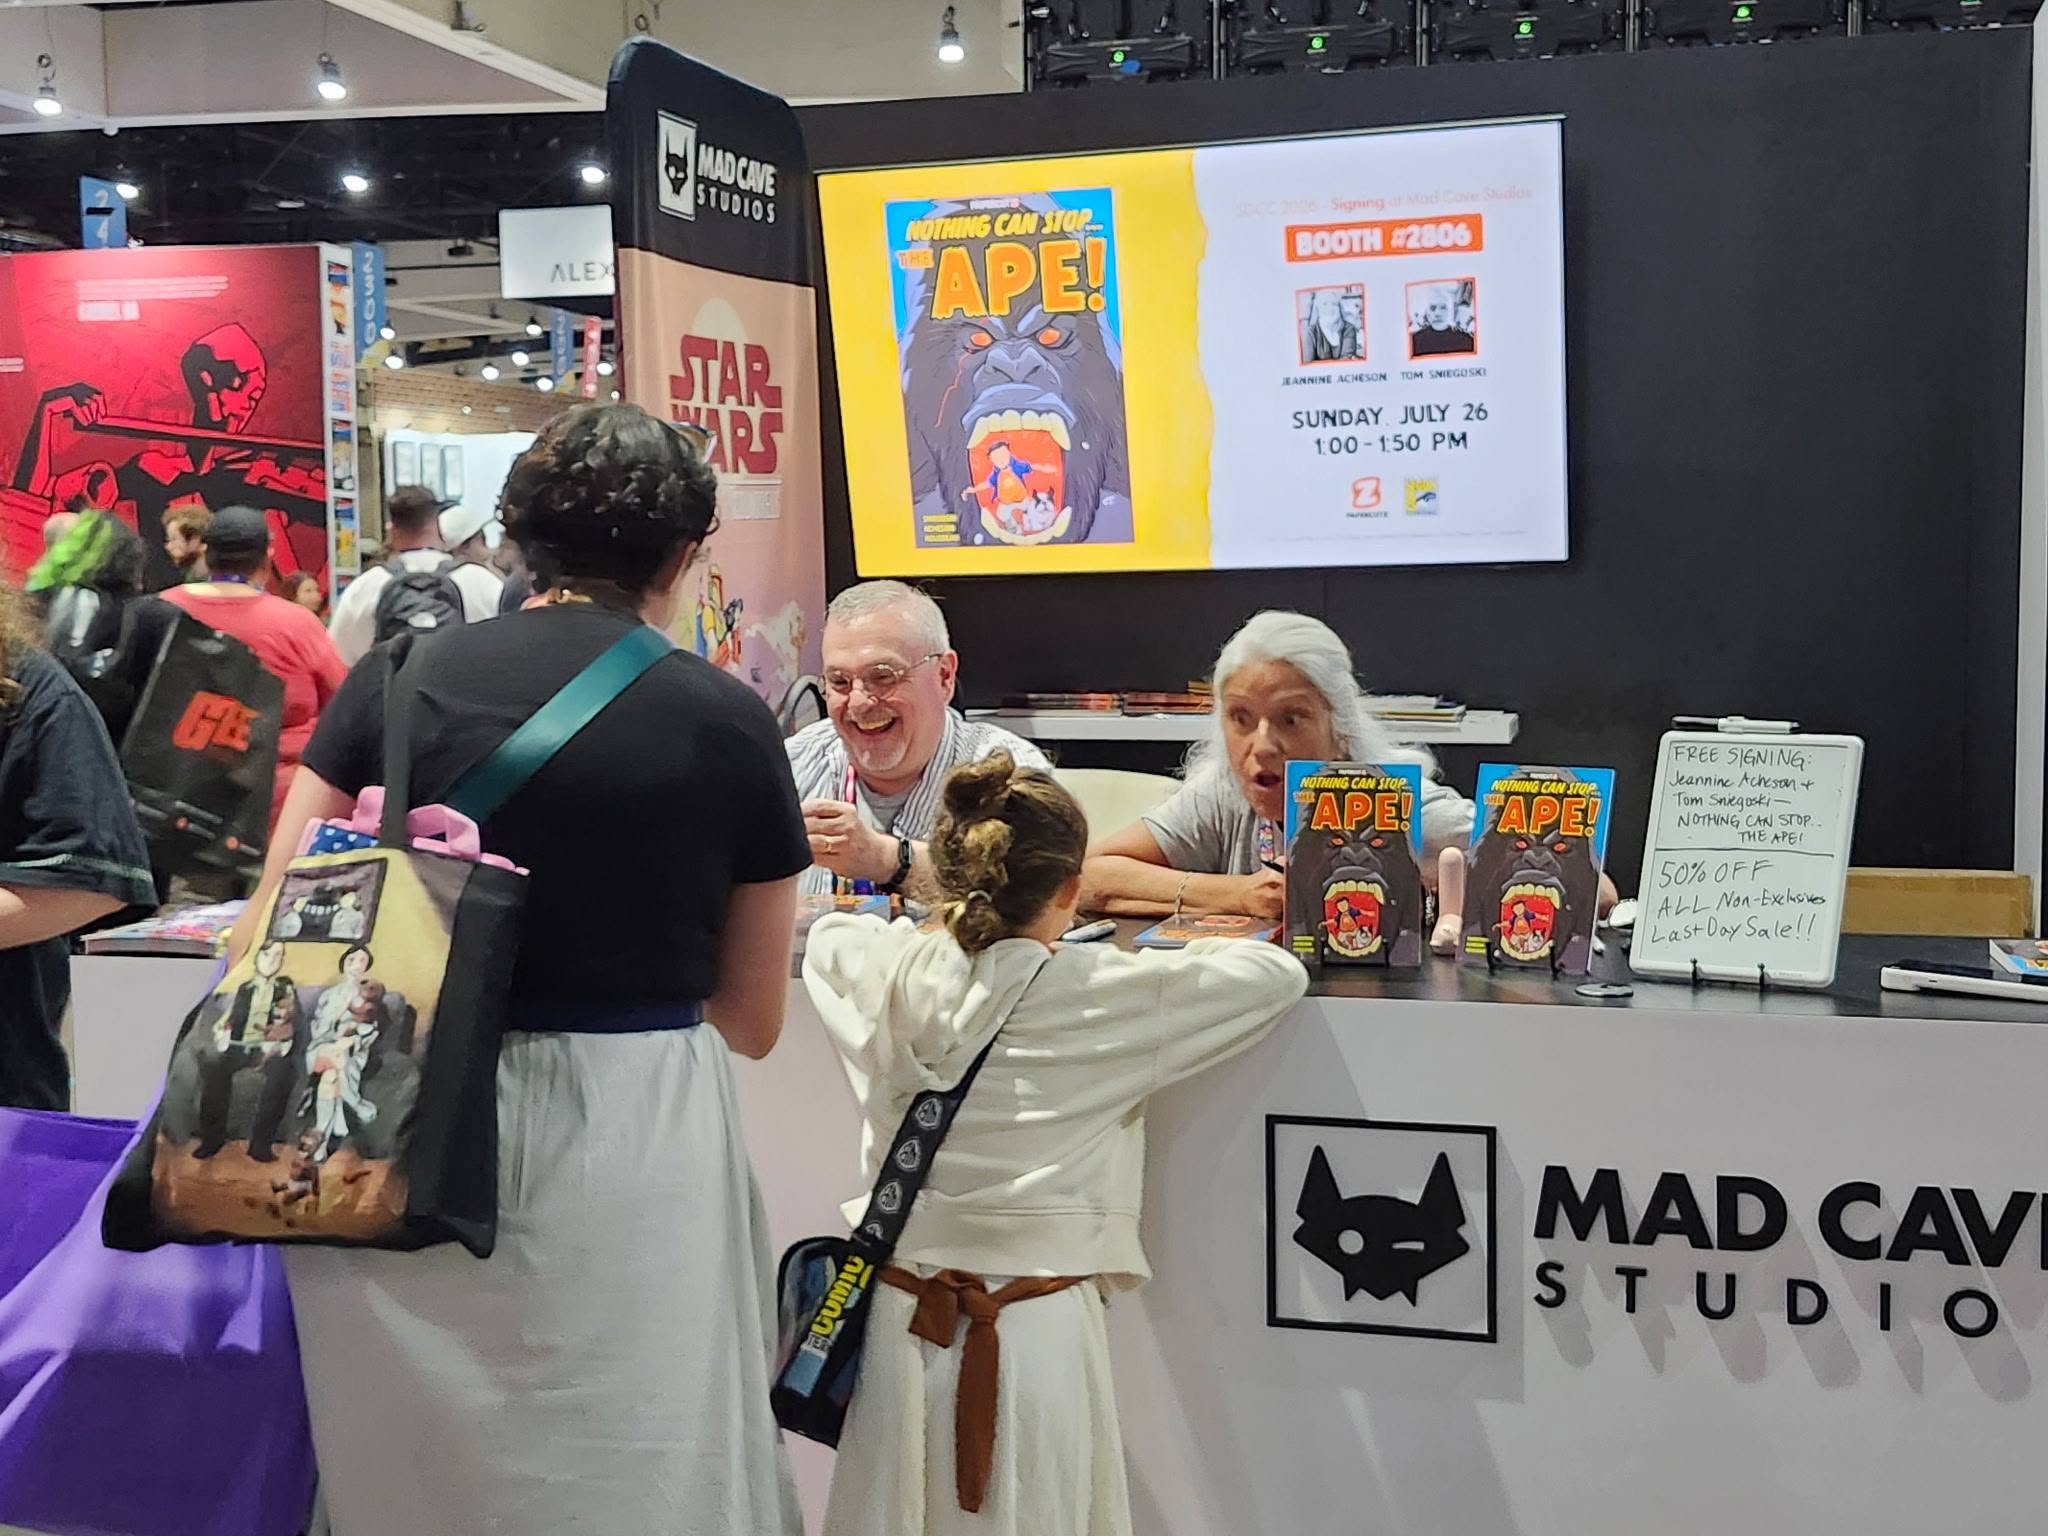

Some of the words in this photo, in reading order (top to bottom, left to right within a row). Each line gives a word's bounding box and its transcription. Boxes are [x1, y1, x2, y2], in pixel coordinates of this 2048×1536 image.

[697, 143, 737, 185] MAD
[737, 157, 778, 197] CAVE
[696, 183, 776, 224] STUDIOS
[1330, 195, 1385, 212] Signing
[1482, 185, 1534, 201] Studios
[906, 214, 990, 242] NOTHING
[993, 212, 1038, 238] CAN
[1294, 227, 1384, 258] BOOTH
[1390, 222, 1473, 249] #2806
[897, 248, 935, 270] THE
[931, 236, 1108, 320] APE!
[669, 334, 783, 408] STAR
[1281, 374, 1333, 386] JEANNINE
[1337, 372, 1388, 383] ACHESON
[1400, 370, 1423, 381] TOM
[1399, 403, 1450, 424] JULY
[1462, 402, 1489, 421] 26
[1432, 431, 1469, 452] PM
[1673, 745, 1719, 763] FREE
[1727, 747, 1812, 771] SIGNING:
[1300, 776, 1349, 790] NOTHING
[1351, 776, 1377, 790] CAN
[1491, 780, 1540, 794] NOTHING
[1541, 781, 1567, 794] CAN
[1669, 770, 1735, 787] Jeannine
[1738, 771, 1797, 791] Acheson
[1310, 792, 1414, 832] APE!
[1673, 791, 1704, 807] Tom
[1496, 795, 1602, 838] APE!
[1677, 812, 1740, 830] NOTHING
[1745, 813, 1774, 828] CAN
[1738, 830, 1768, 844] THE
[1658, 860, 1706, 889] 50%
[1713, 859, 1775, 884] OFF
[1657, 894, 1711, 920] ALL
[1651, 923, 1704, 944] Last
[1706, 915, 1743, 942] Day
[1745, 912, 1817, 943] Sale!!
[1533, 1164, 1789, 1253] MAD
[1816, 1180, 2048, 1272] CAV
